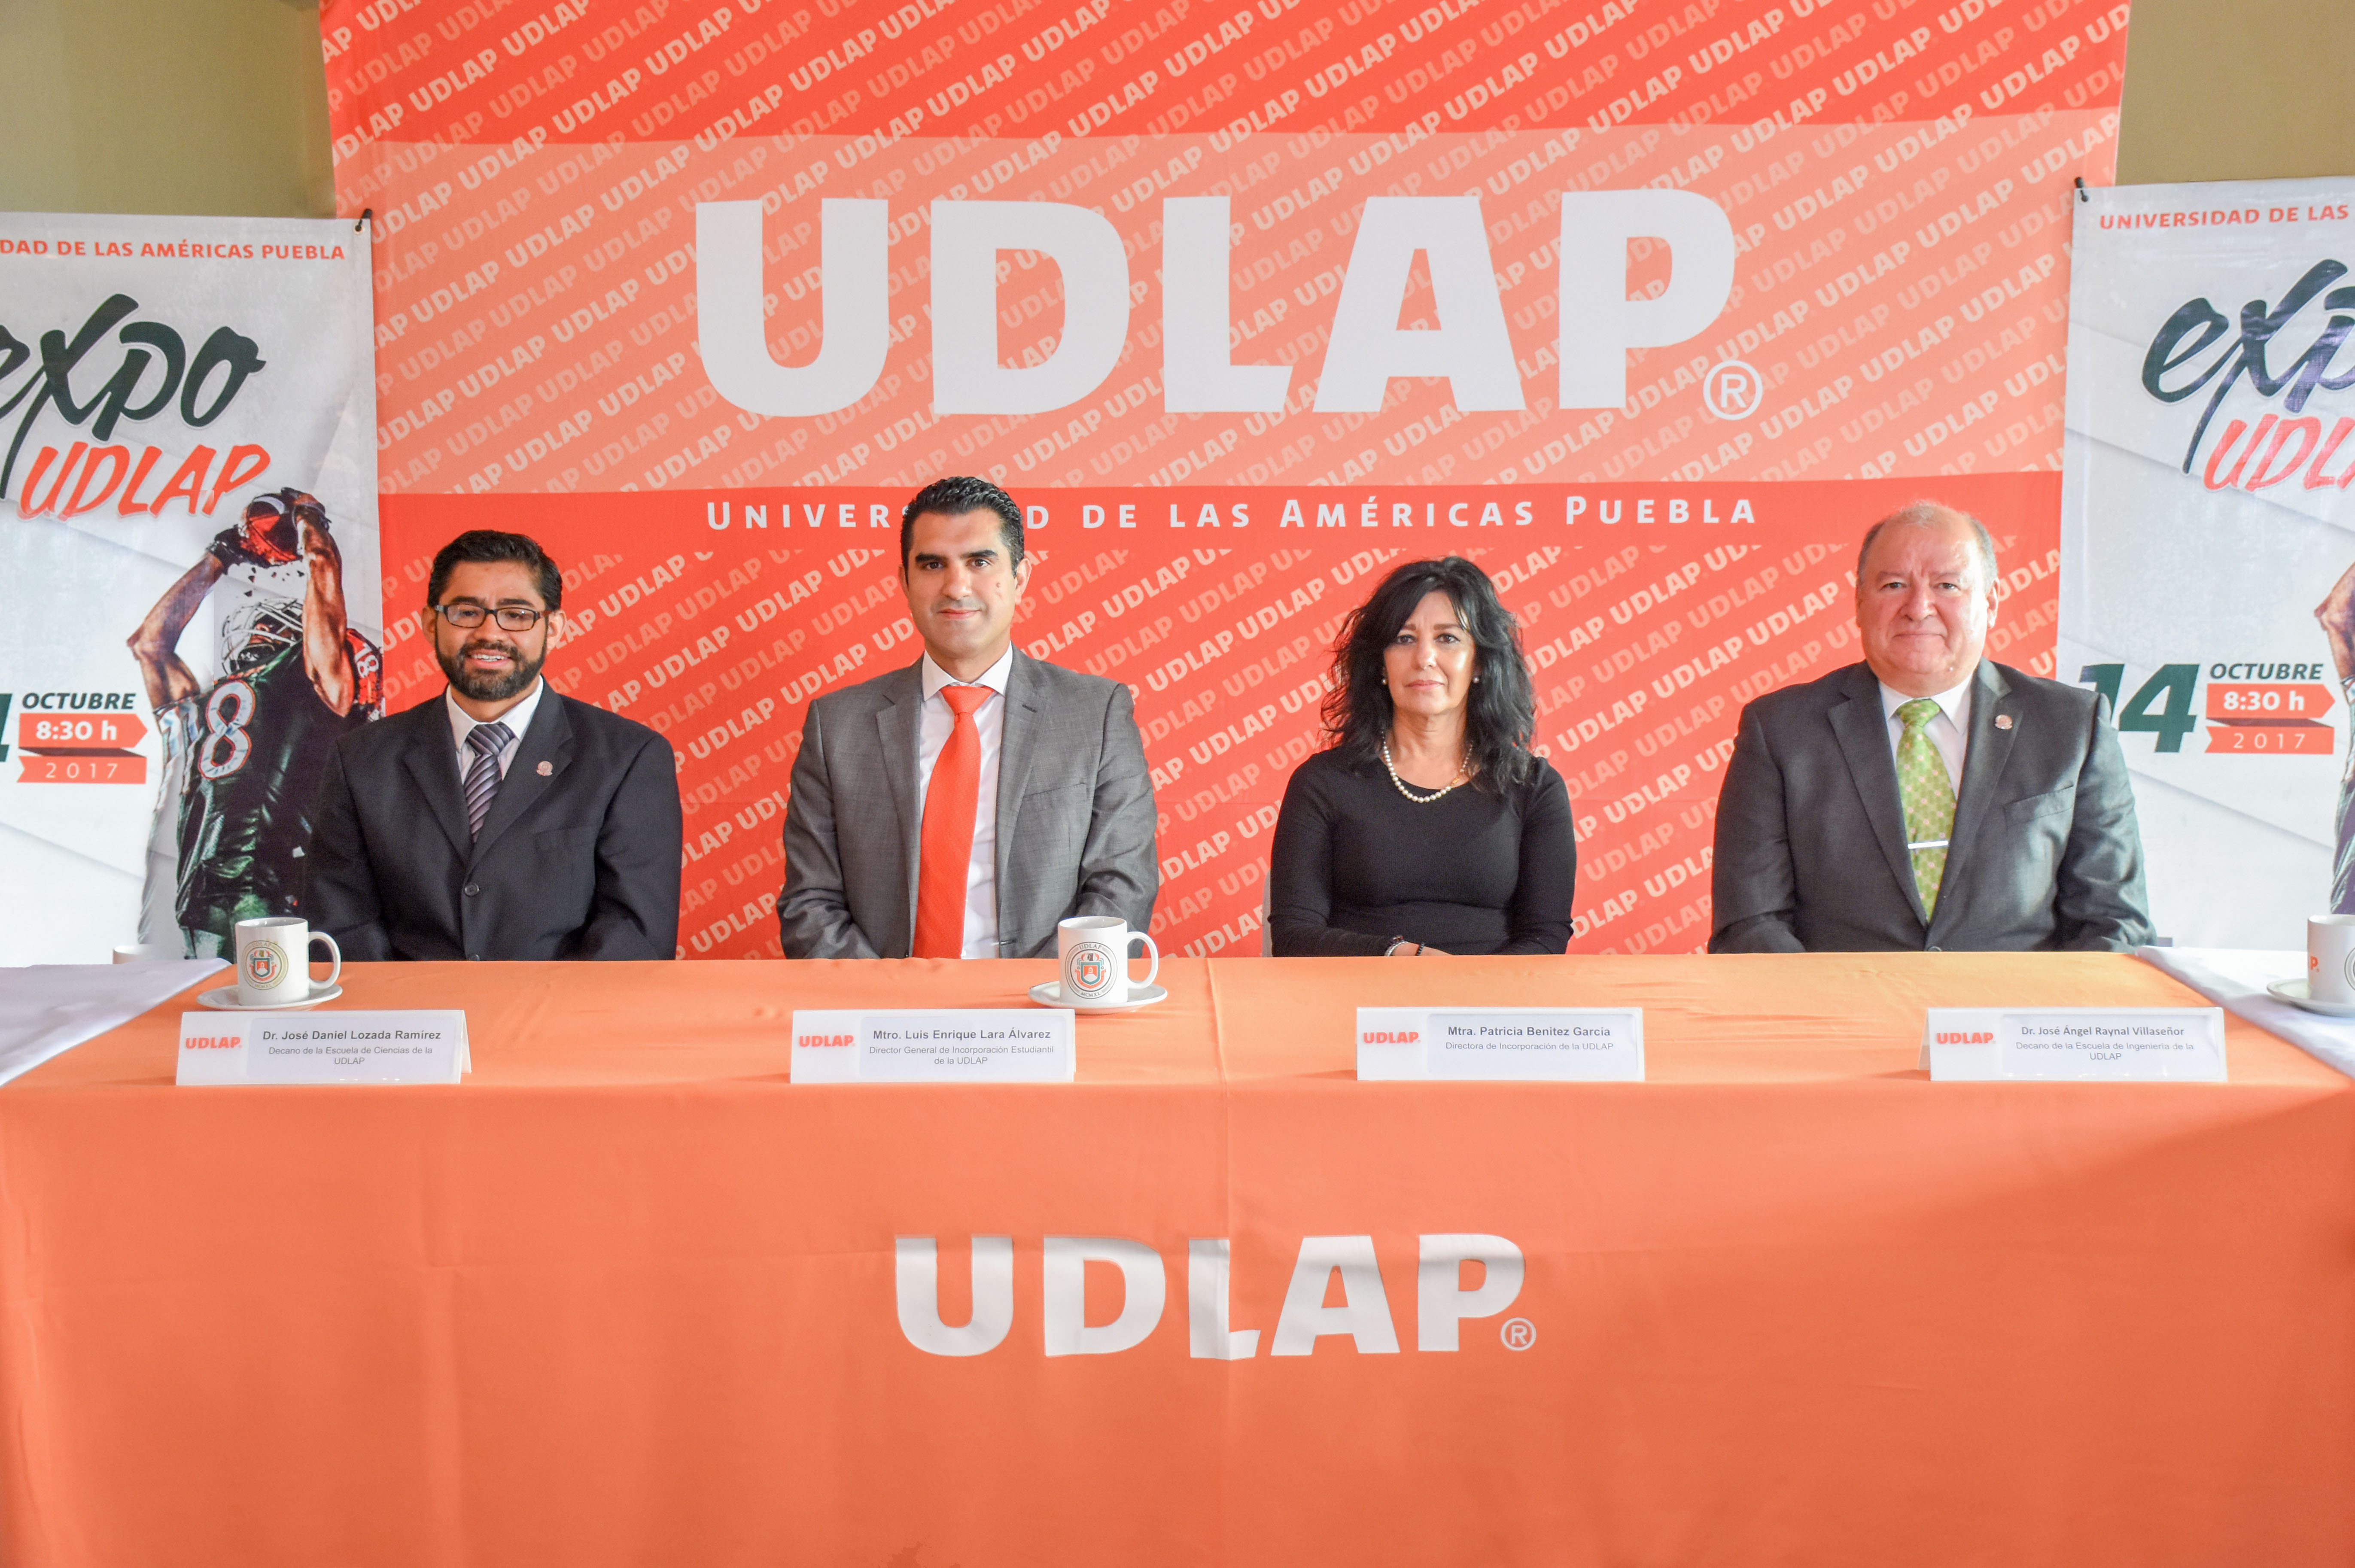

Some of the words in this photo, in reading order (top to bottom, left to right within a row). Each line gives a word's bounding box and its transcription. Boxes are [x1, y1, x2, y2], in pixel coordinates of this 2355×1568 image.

[409, 49, 496, 111] UDLAP
[489, 55, 577, 118] UDLAP
[867, 36, 955, 97] UDLAP
[1384, 39, 1476, 103] UDLAP
[1731, 88, 1827, 152] UDLAP
[1833, 27, 1930, 95] UDLAP
[458, 126, 547, 189] UDLAP
[552, 68, 640, 133] UDLAP
[645, 8, 732, 75] UDLAP
[835, 106, 924, 168] UDLAP
[927, 54, 1015, 116] UDLAP
[971, 130, 1061, 193] UDLAP
[1068, 71, 1158, 136] UDLAP
[1164, 11, 1253, 76] UDLAP
[1111, 146, 1202, 212] UDLAP
[1210, 89, 1299, 151] UDLAP
[1305, 33, 1396, 97] UDLAP
[1487, 128, 1580, 194] UDLAP
[1588, 66, 1681, 133] UDLAP
[1689, 9, 1784, 73] UDLAP
[1252, 167, 1342, 230] UDLAP
[1348, 111, 1441, 175] UDLAP
[1444, 52, 1537, 120] UDLAP
[1773, 165, 1868, 230] UDLAP
[1874, 103, 1972, 172] UDLAP
[411, 261, 499, 322] UDLAP
[505, 205, 594, 267] UDLAP
[600, 145, 689, 211] UDLAP
[694, 85, 782, 151] UDLAP
[789, 29, 876, 91] UDLAP
[2100, 209, 2260, 229] UNIVERSIDAD
[2269, 207, 2298, 222] DE
[2309, 205, 2348, 221] LAS
[57, 241, 86, 255] DE
[95, 242, 133, 256] LAS
[141, 239, 253, 258] AMÉRICAS
[262, 245, 345, 259] PUEBLA
[1715, 300, 1808, 363] UDLAP
[1815, 241, 1910, 307] UDLAP
[1916, 179, 2013, 247] UDLAP
[457, 336, 545, 397] UDLAP
[551, 279, 639, 342] UDLAP
[1760, 376, 1853, 439] UDLAP
[1860, 316, 1954, 381] UDLAP
[1960, 254, 2054, 322] UDLAP
[505, 410, 592, 471] UDLAP
[598, 352, 685, 416] UDLAP
[1013, 410, 1101, 471] UDLAP
[1904, 391, 1998, 456] UDLAP
[645, 425, 731, 488] UDLAP
[1523, 411, 1613, 474] UDLAP
[20, 441, 271, 521] UDLAP
[708, 501, 1049, 530] UNIVERD
[1082, 504, 1137, 528] DE
[1170, 503, 1250, 528] LAS
[1280, 495, 1533, 528] AMÉRICAS
[1566, 495, 1755, 525] PUEBLA
[599, 555, 685, 617] UDLAP
[675, 558, 761, 620] UDLAP
[1102, 557, 1190, 617] UDLAP
[1179, 562, 1266, 623] UDLAP
[1610, 562, 1700, 624] UDLAP
[644, 626, 730, 687] UDLAP
[736, 570, 822, 632] UDLAP
[1146, 630, 1233, 691] UDLAP
[1236, 578, 1324, 639] UDLAP
[1557, 690, 1646, 751] UDLAP
[1652, 637, 1743, 698] UDLAP
[1746, 582, 1838, 645] UDLAP
[2210, 663, 2323, 680] OCTUBRE
[22, 693, 136, 709] OCTUBRE
[37, 721, 92, 740] 8:30
[102, 720, 116, 740] h
[688, 698, 774, 758] UDLAP
[780, 644, 866, 704] UDLAP
[2224, 692, 2280, 710] 8:30
[2289, 691, 2304, 710] h
[1189, 705, 1276, 764] UDLAP
[2234, 733, 2305, 748] 2017
[46, 763, 117, 778] 2017
[1603, 764, 1690, 823] UDLAP
[691, 893, 776, 952] UDLAP
[185, 1036, 241, 1049] UDLAP
[263, 1031, 278, 1040] Dr.
[281, 1030, 308, 1040] José
[312, 1030, 347, 1039] Daniel
[350, 1030, 391, 1039] Lozada
[395, 1030, 441, 1039] Ramírez
[302, 1046, 313, 1054] de
[316, 1046, 323, 1054] la
[374, 1046, 410, 1054] Ciencias
[799, 1034, 854, 1048] UDLAP
[873, 1030, 901, 1039] Mtro.
[905, 1030, 929, 1039] Luis
[933, 1030, 977, 1041] Enrique
[980, 1030, 1005, 1039] Lara
[1008, 1027, 1051, 1039] Álvarez
[904, 1046, 937, 1054] General
[952, 1045, 1008, 1055] Incorporación
[1363, 1031, 1419, 1044] UDLAP
[1448, 1026, 1476, 1036] Mtra.
[1480, 1027, 1523, 1036] Patricia
[1573, 1027, 1610, 1036] García
[1499, 1042, 1556, 1051] Incorporación
[1936, 1032, 1994, 1045] UDLAP
[2021, 1027, 2036, 1035] Dr.
[2038, 1026, 2060, 1035] José
[2063, 1024, 2092, 1037] Ángel
[2095, 1027, 2130, 1037] Raynal
[2132, 1027, 2185, 1036] Villaseñor
